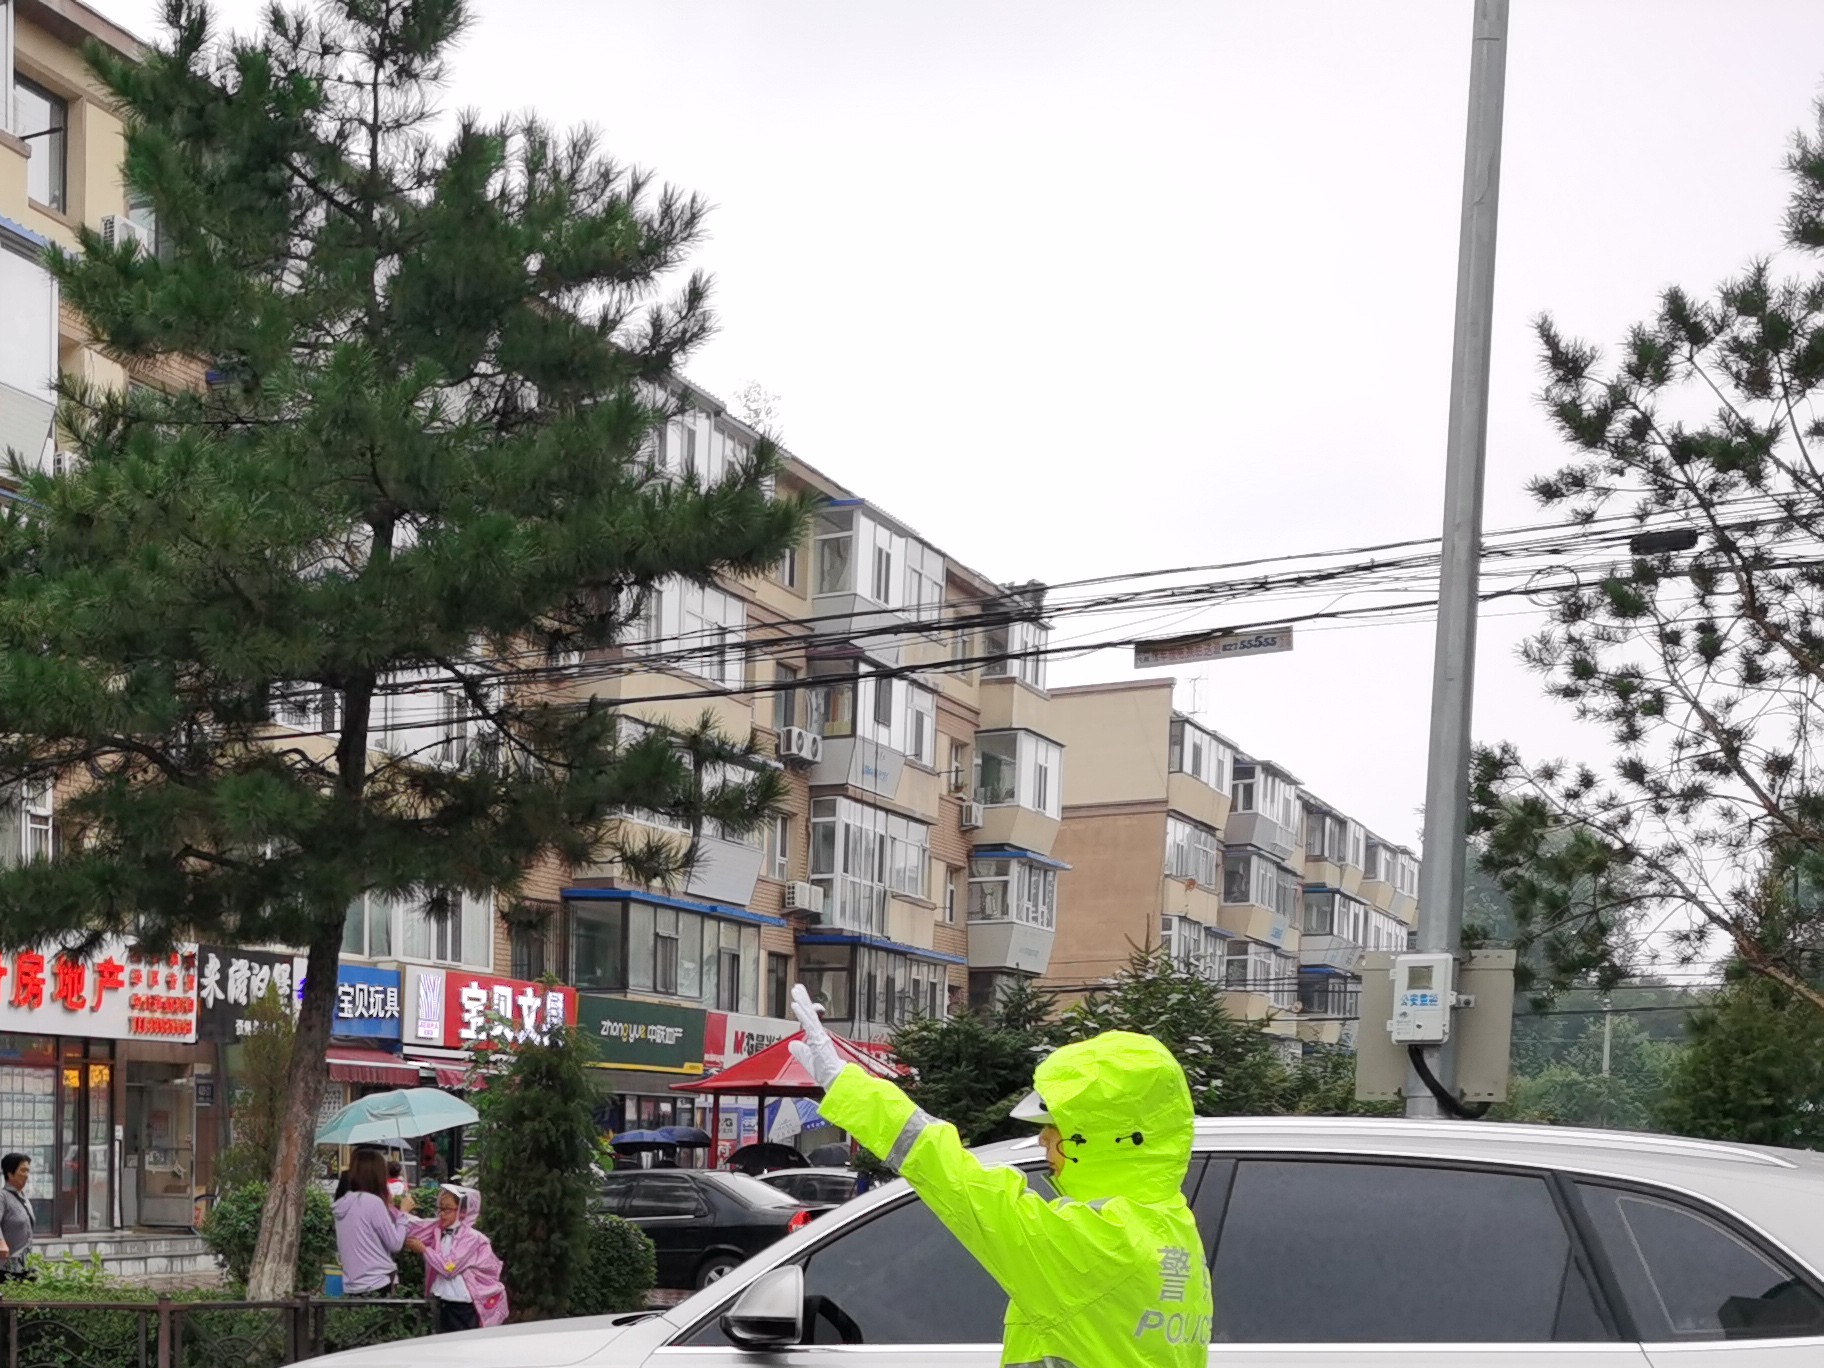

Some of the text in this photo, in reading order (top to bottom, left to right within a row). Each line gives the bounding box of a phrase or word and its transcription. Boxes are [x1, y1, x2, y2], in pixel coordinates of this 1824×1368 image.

[338, 982, 400, 1019] 宝贝玩具
[459, 981, 566, 1048] 宝贝文具
